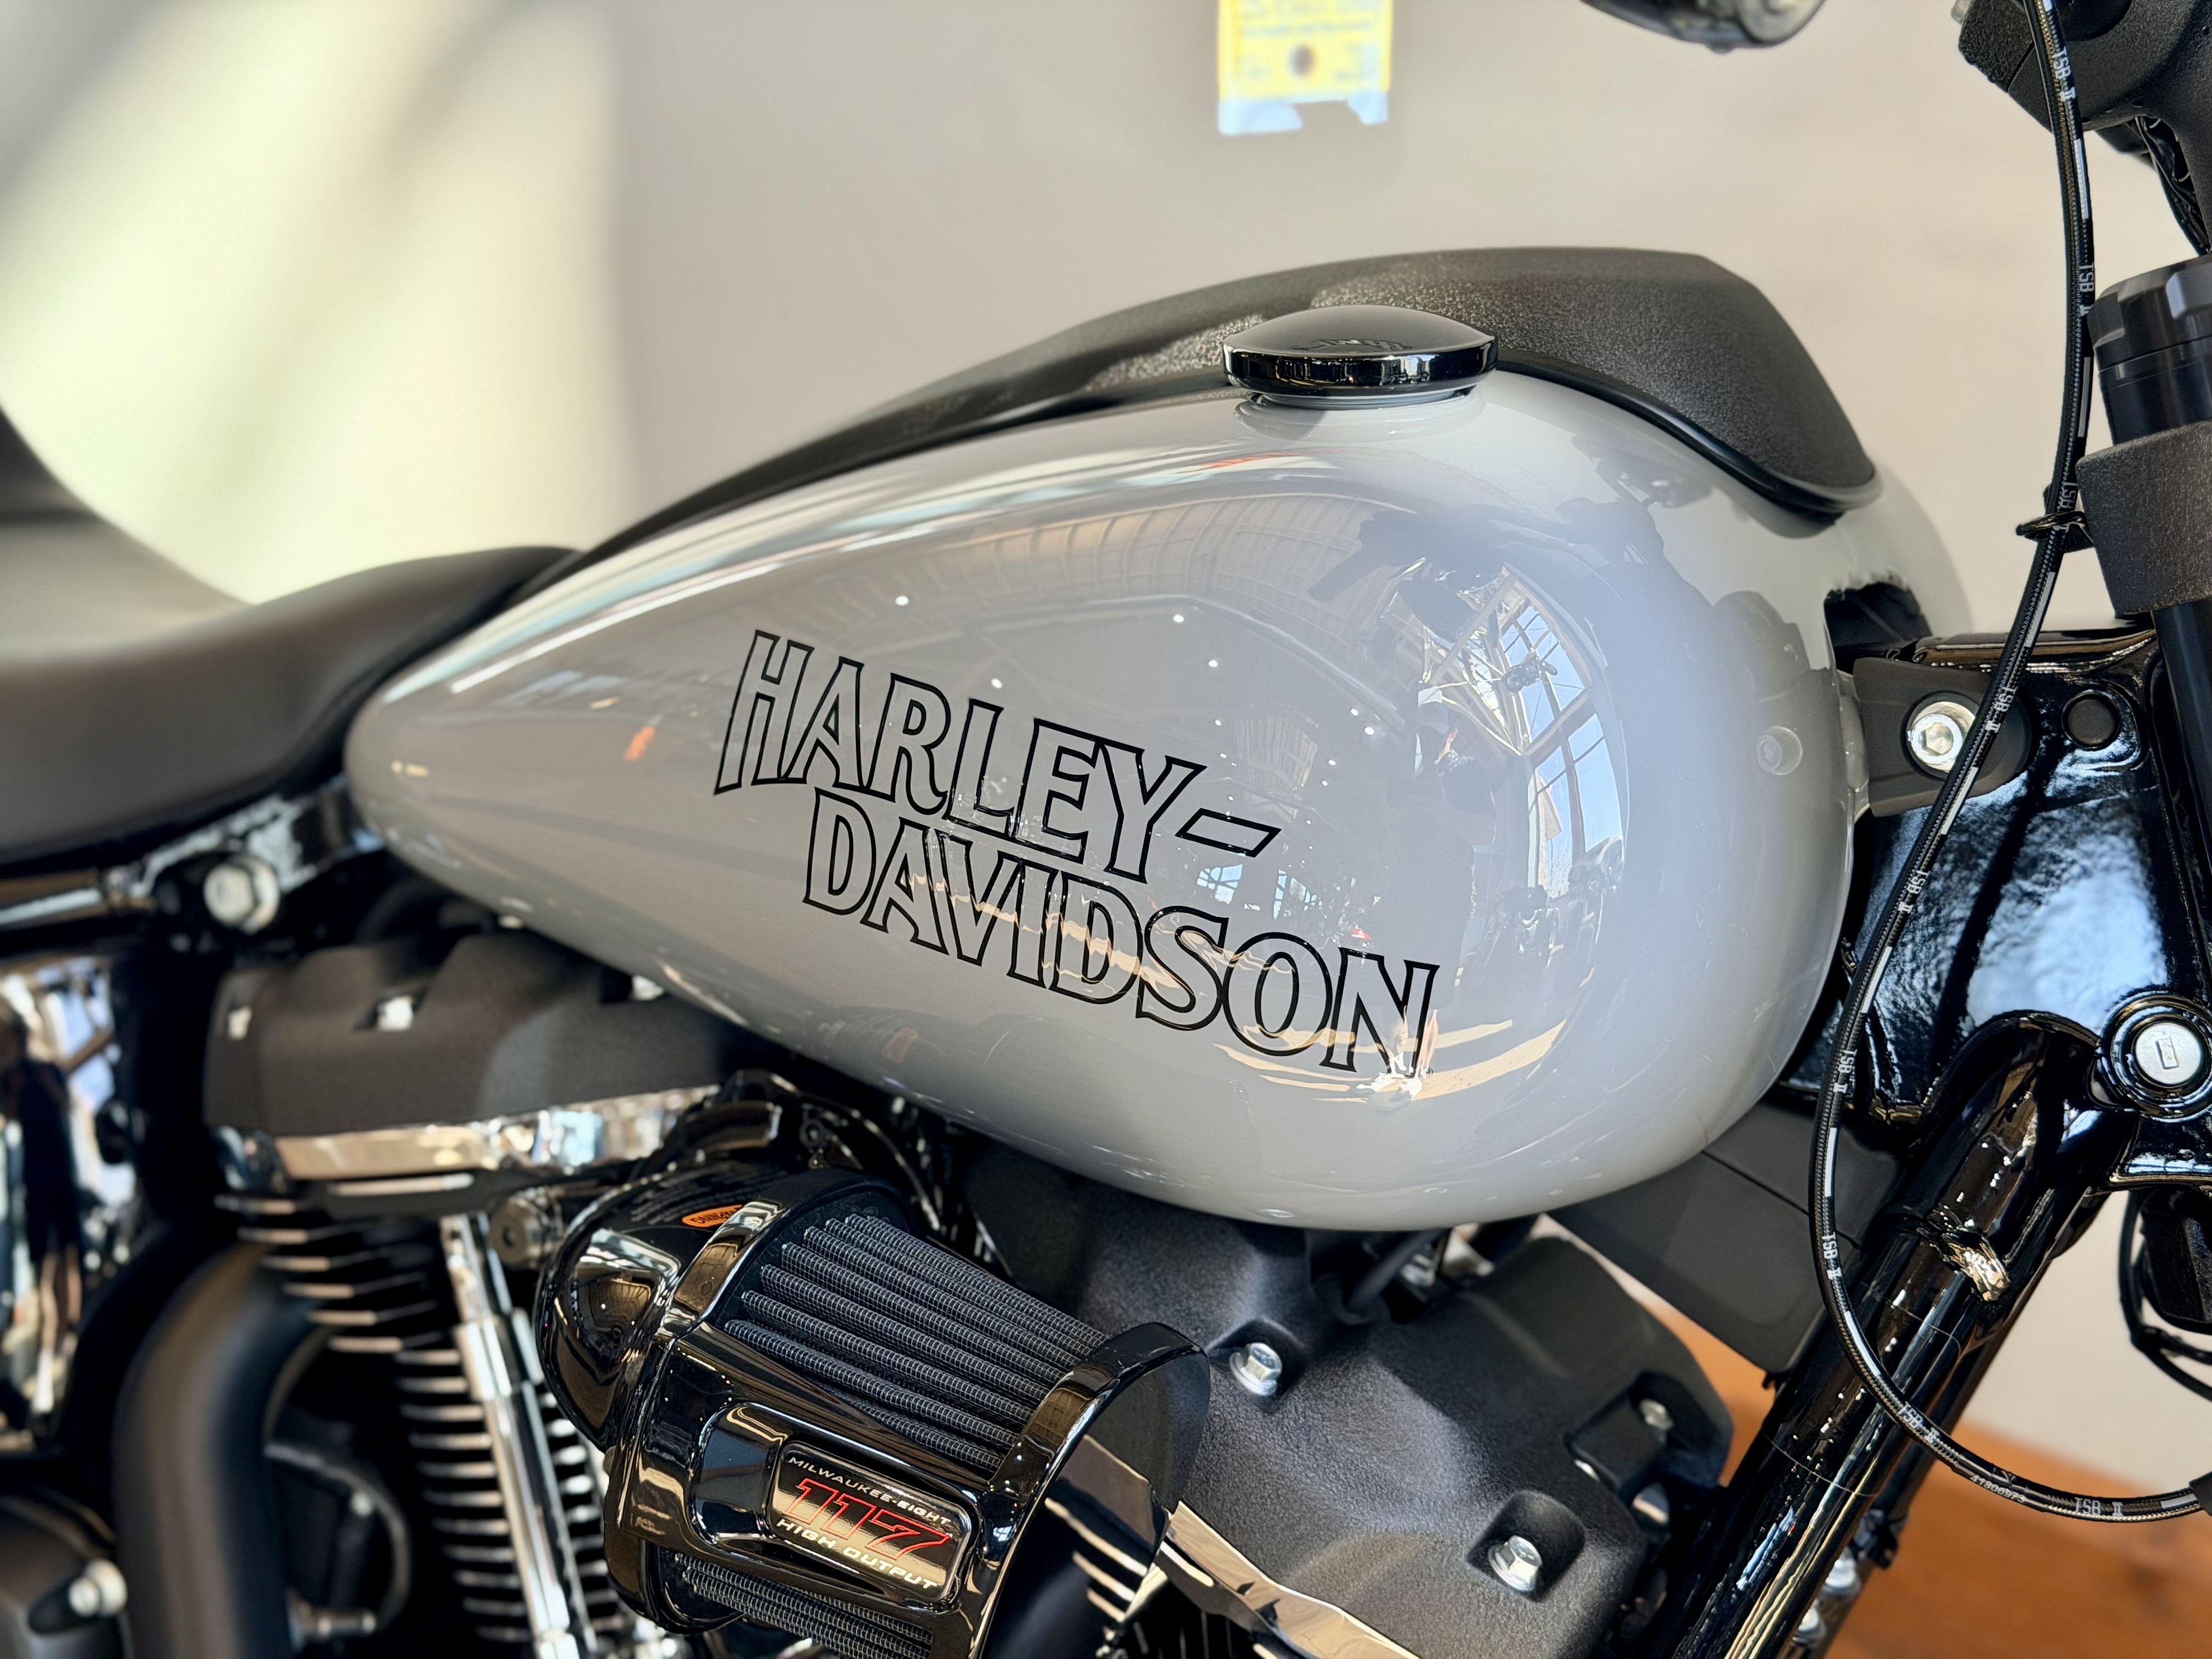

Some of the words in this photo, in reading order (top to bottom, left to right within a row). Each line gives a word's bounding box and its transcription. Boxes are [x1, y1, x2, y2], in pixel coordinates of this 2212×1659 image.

[714, 629, 1282, 884] HARLEY-
[803, 787, 1441, 1079] DAVIDSON
[783, 1477, 953, 1561] 117
[788, 1456, 952, 1525] MILWAUKEE-EIGHT
[776, 1518, 837, 1549] HIGH
[843, 1546, 938, 1589] OUTPUT
